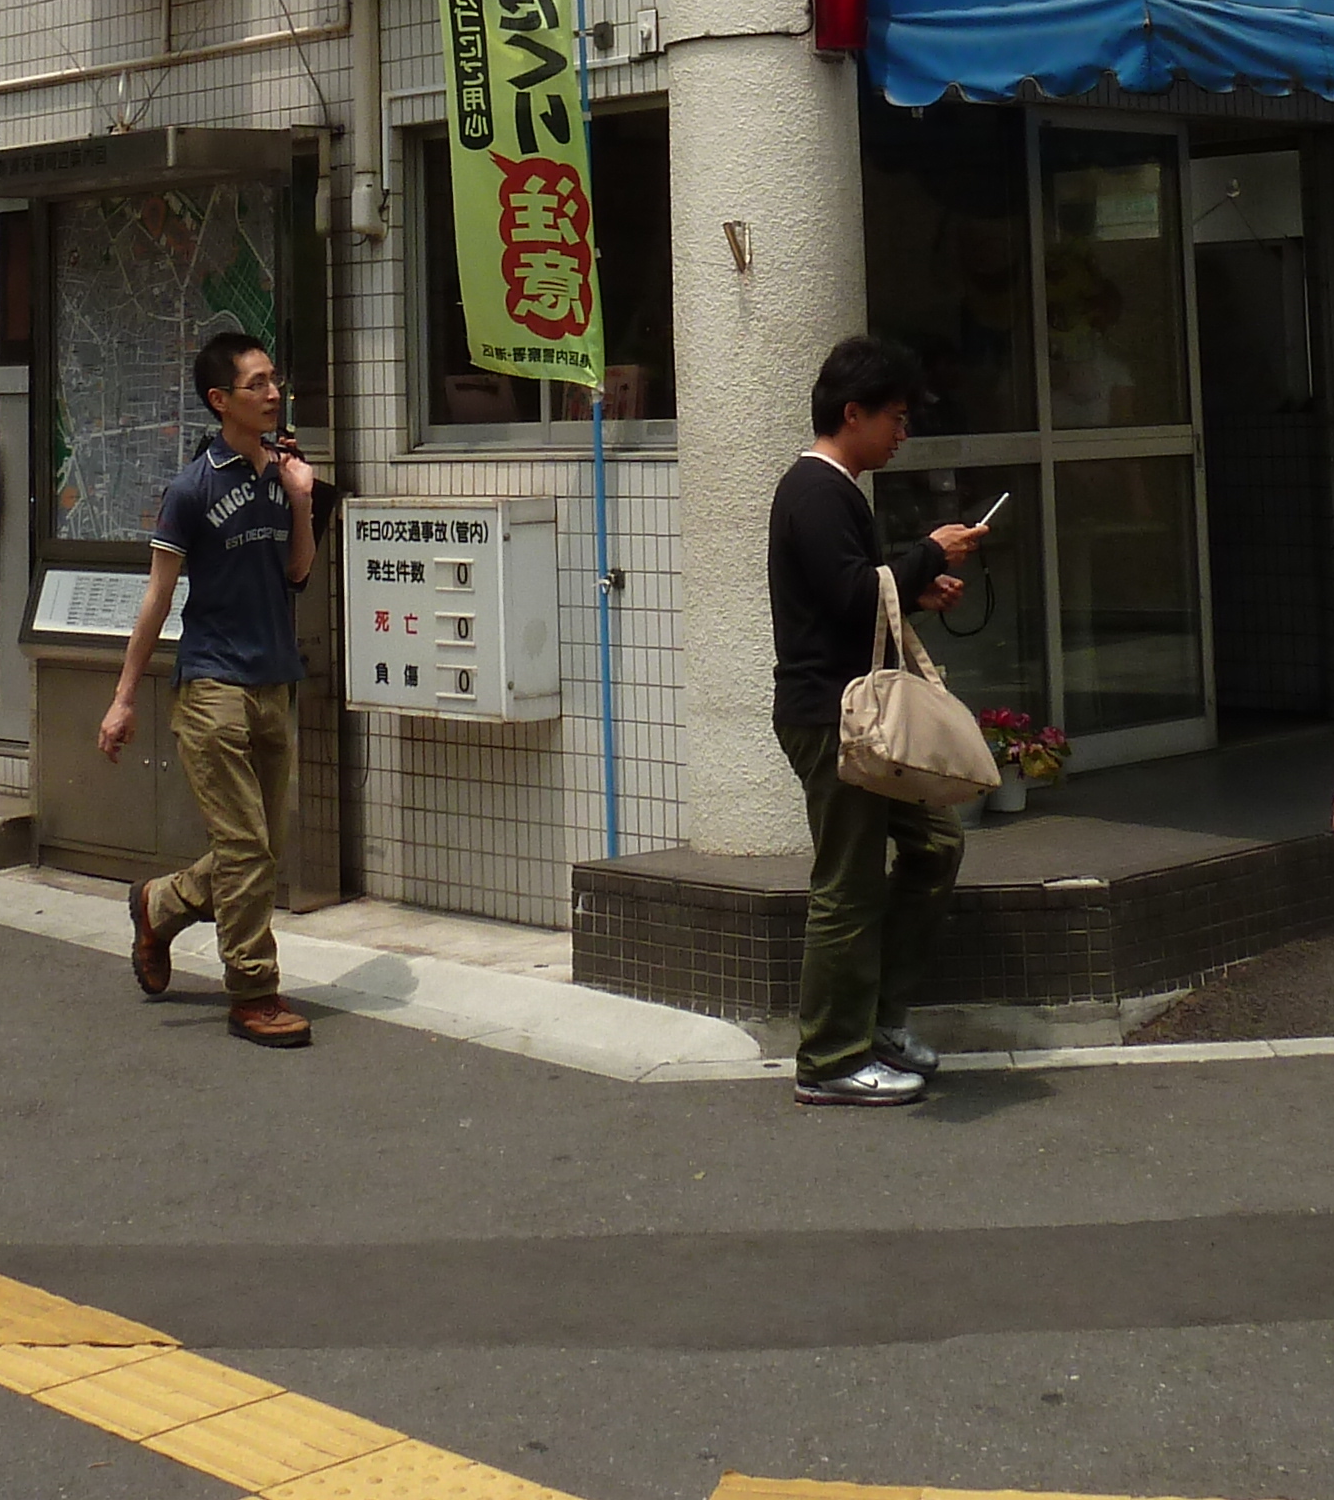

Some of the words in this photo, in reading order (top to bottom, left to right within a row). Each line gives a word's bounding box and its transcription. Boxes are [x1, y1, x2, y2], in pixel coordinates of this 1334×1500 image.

[366, 559, 426, 584] 発生件数
[456, 562, 469, 586] 0
[457, 616, 470, 640] 0
[458, 669, 471, 693] 0
